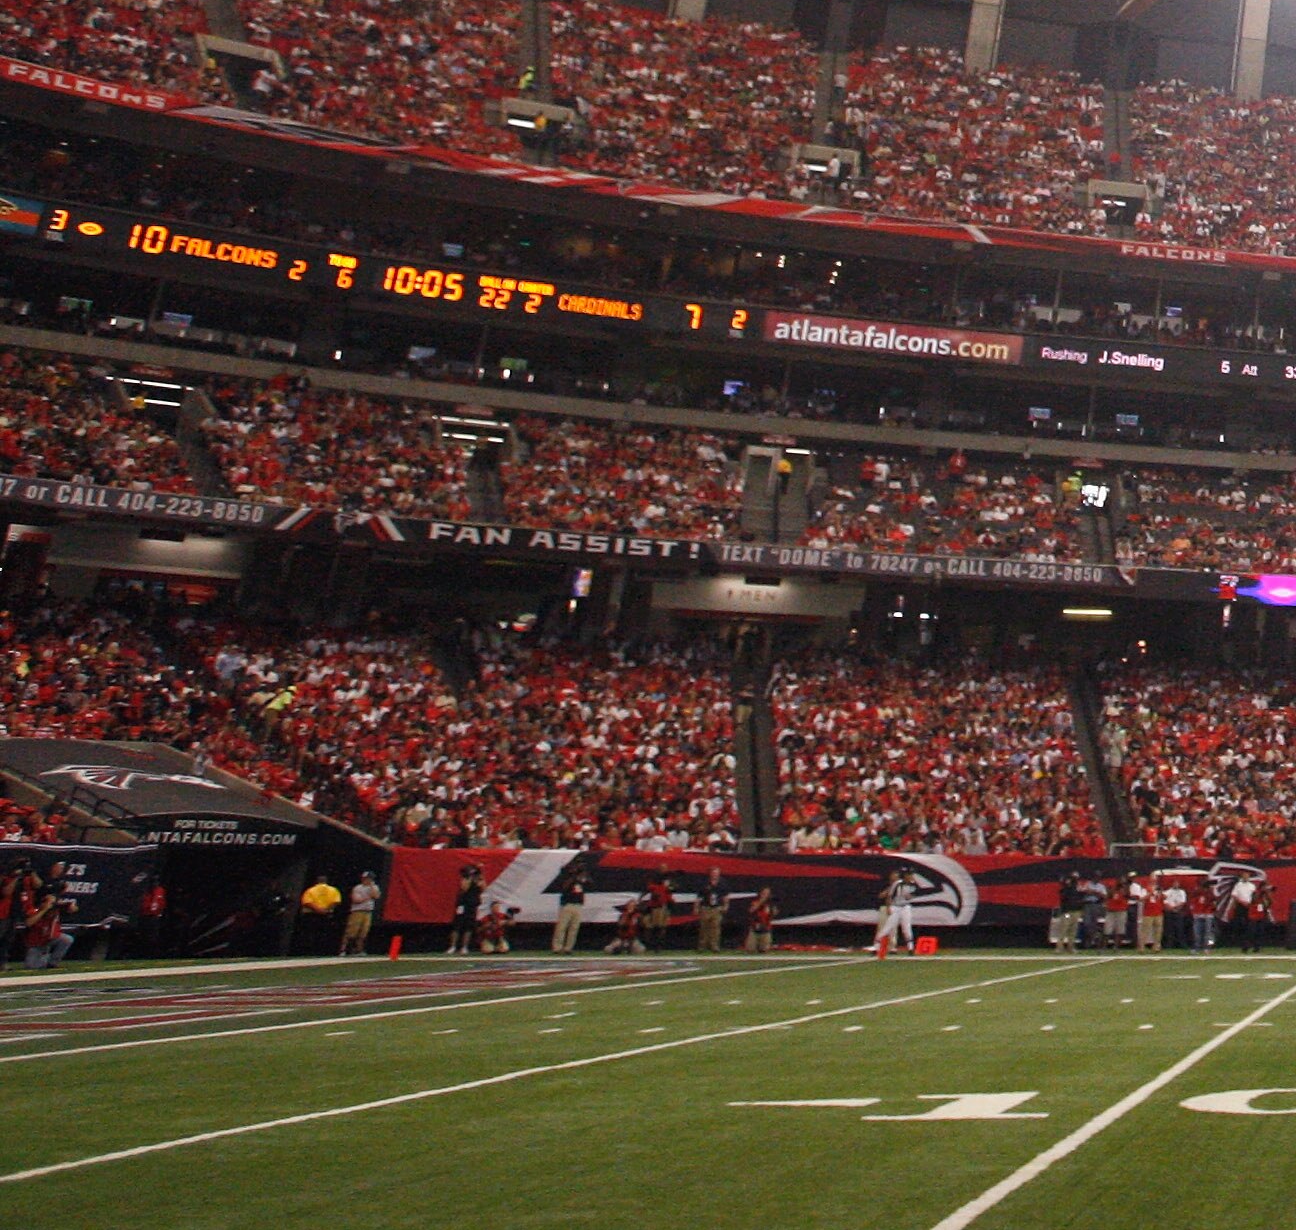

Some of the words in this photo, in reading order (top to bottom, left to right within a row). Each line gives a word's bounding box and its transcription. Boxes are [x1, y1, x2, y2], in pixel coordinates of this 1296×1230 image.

[8, 63, 167, 109] FALCONS
[49, 210, 68, 231] 3
[128, 224, 168, 254] 10
[170, 235, 279, 269] FALCONS
[1120, 244, 1226, 263] FALCONS
[288, 260, 307, 281] 2
[336, 269, 353, 289] 6
[383, 266, 465, 301] 10:05
[479, 288, 512, 310] 22
[525, 294, 542, 314] 2
[557, 293, 644, 321] CARDINALS
[685, 303, 703, 330] 7
[731, 309, 749, 330] 2
[774, 319, 1009, 360] atlantafalcons.com
[1041, 346, 1088, 365] Rushing
[1221, 361, 1230, 374] 5
[25, 484, 48, 501] or
[56, 484, 109, 508] CALL
[429, 522, 512, 545] FAN
[721, 545, 764, 562] TEXT
[846, 554, 864, 569] to
[870, 555, 920, 573] 78247
[948, 559, 987, 577] CALL
[199, 820, 239, 830] TICKETS
